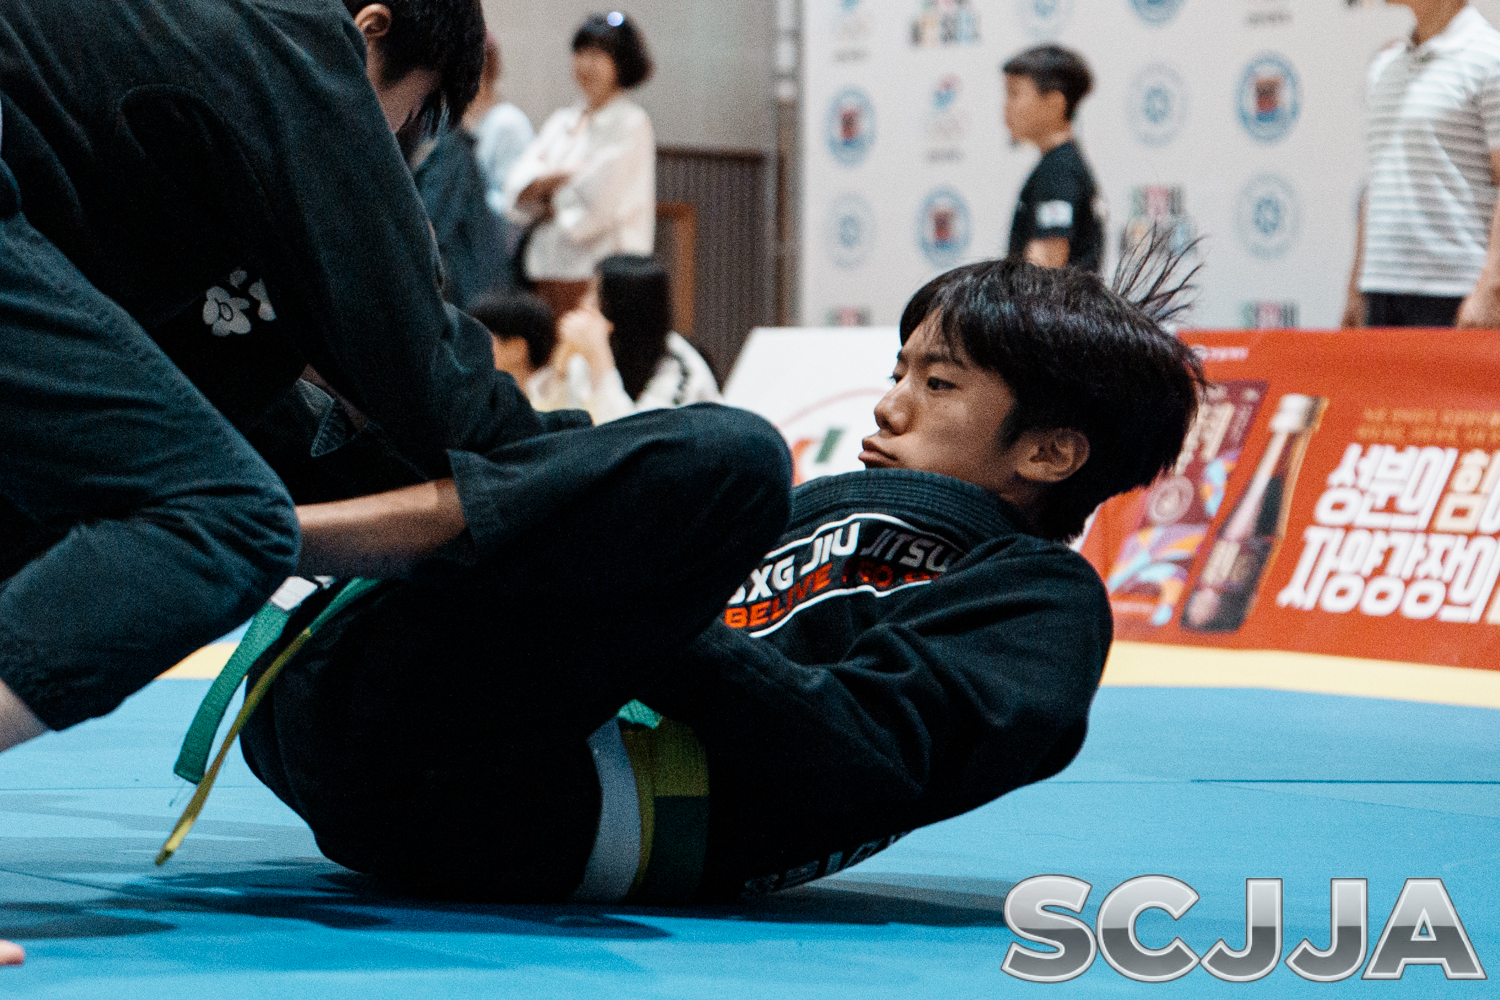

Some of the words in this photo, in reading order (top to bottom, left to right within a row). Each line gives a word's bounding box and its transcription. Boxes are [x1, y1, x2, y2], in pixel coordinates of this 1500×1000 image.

[1314, 443, 1459, 530] 성분의
[799, 521, 861, 577] JIU
[859, 527, 958, 573] JITSU
[1277, 526, 1500, 623] 자양강장의
